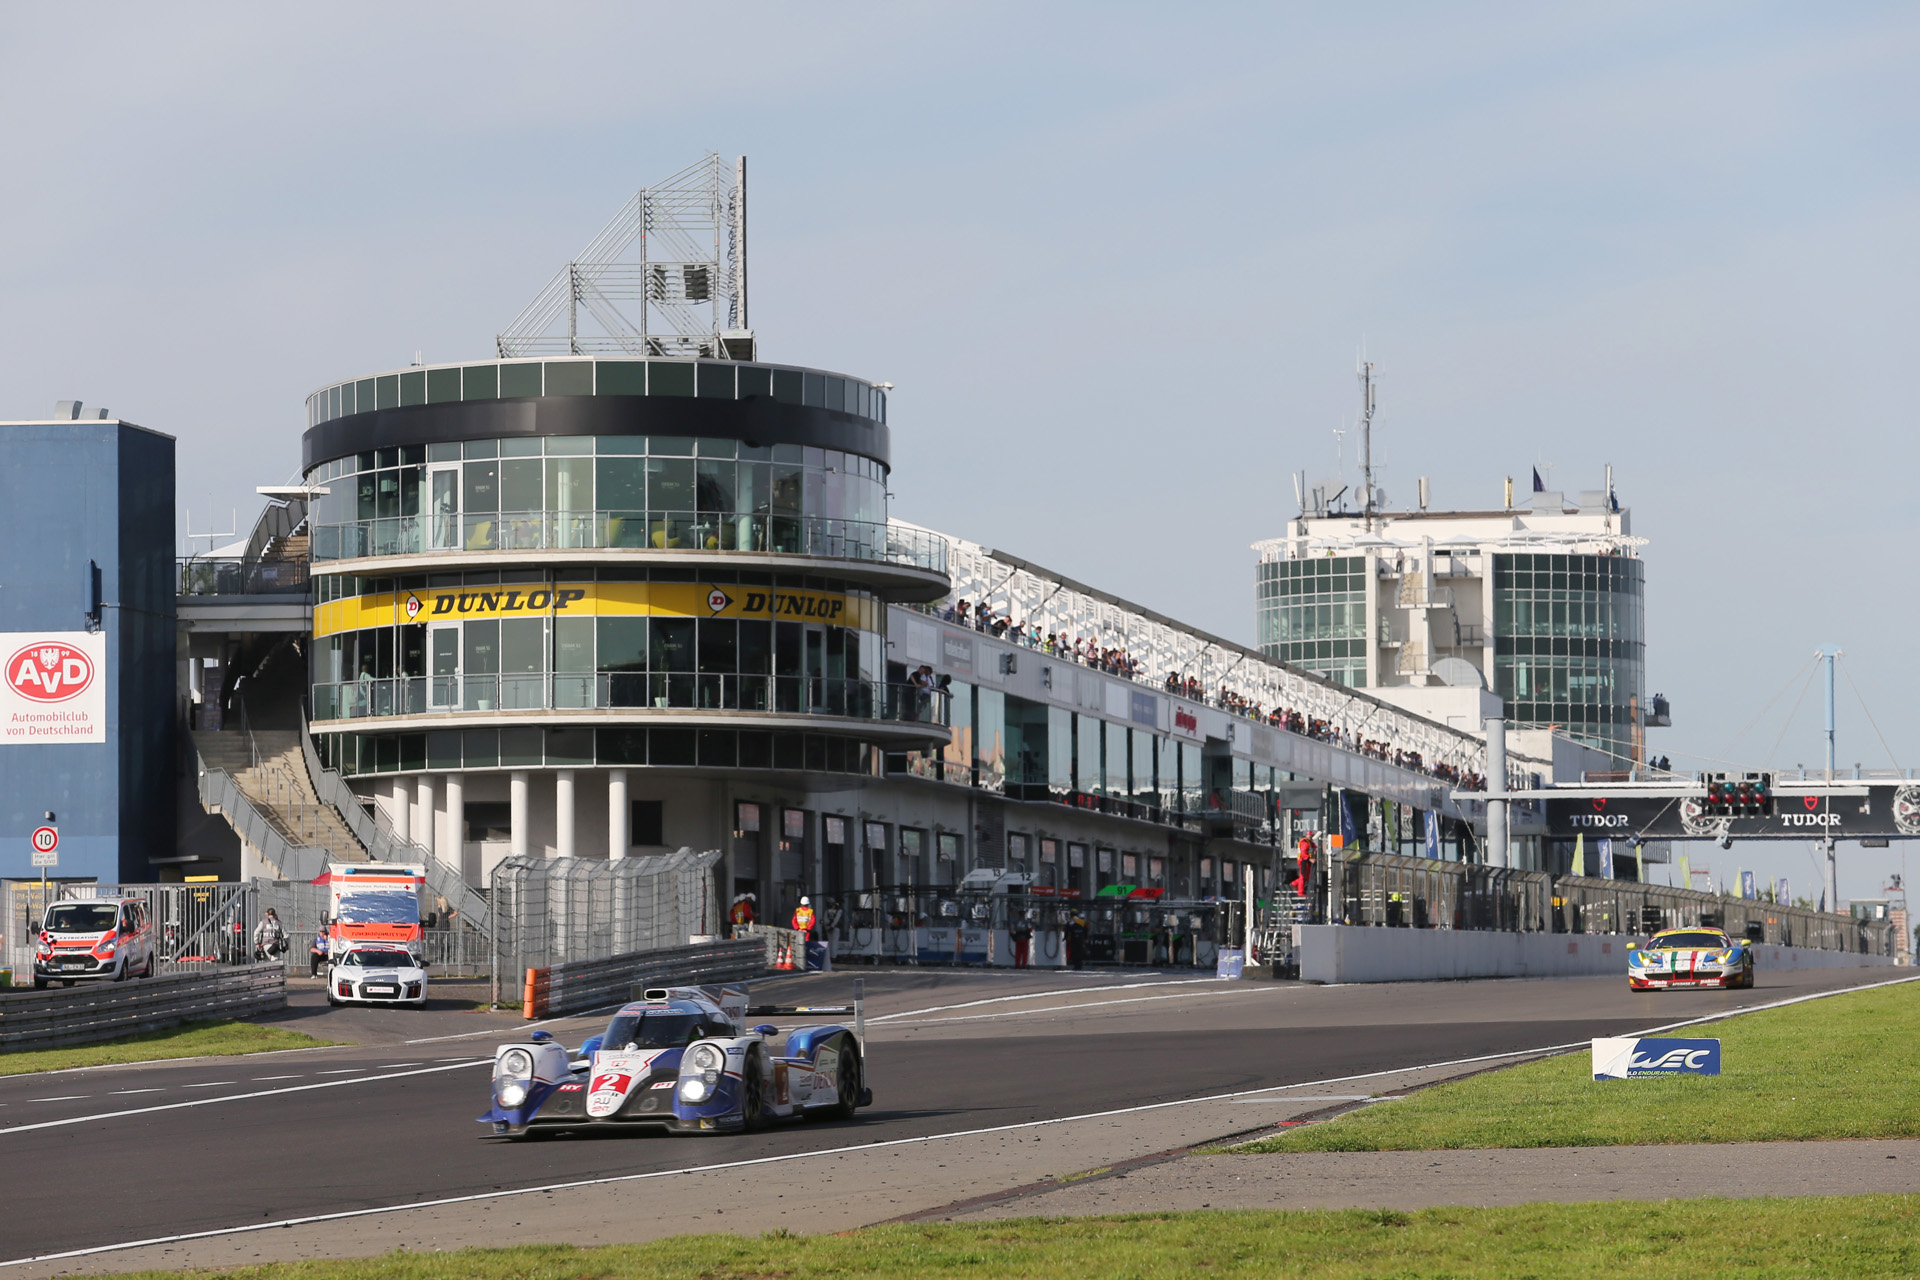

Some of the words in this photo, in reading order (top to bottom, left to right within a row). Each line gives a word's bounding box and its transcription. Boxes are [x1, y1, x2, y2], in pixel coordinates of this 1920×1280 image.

[431, 589, 585, 614] DUNLOP
[742, 592, 843, 618] DUNLOP
[11, 711, 88, 722] Automobilclub
[6, 727, 25, 735] von
[29, 724, 93, 735] Deutschland
[1570, 814, 1629, 827] TUDOR
[1781, 813, 1842, 826] TUDOR
[39, 834, 52, 846] 10
[992, 868, 1001, 877] 13
[1020, 873, 1031, 881] 12
[1117, 886, 1127, 894] 91
[1145, 889, 1156, 898] 92
[1628, 1048, 1711, 1069] WEC
[598, 1073, 621, 1091] 2
